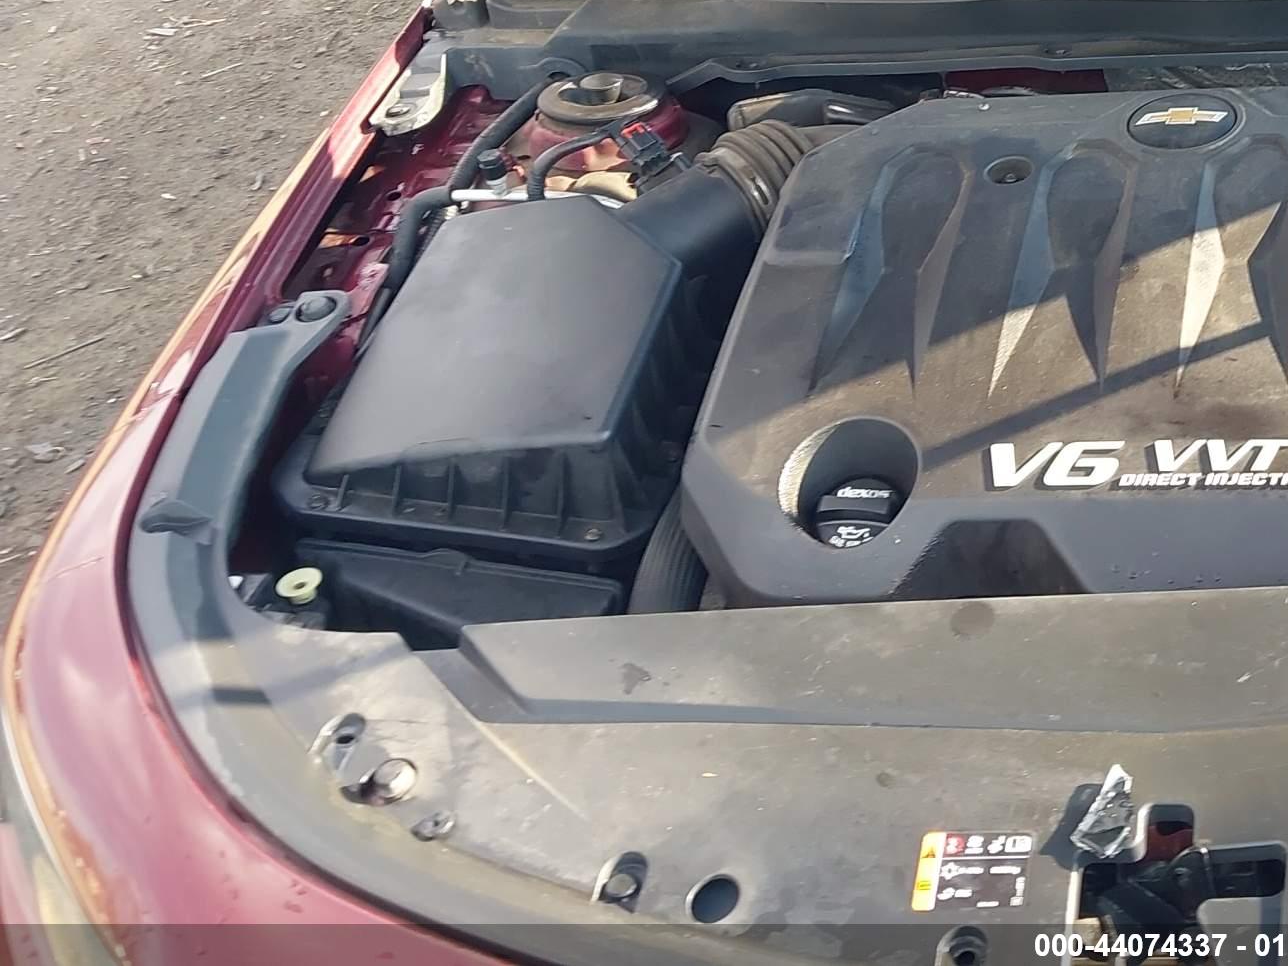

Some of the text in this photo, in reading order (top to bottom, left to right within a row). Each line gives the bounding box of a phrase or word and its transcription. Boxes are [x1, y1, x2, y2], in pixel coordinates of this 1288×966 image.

[990, 440, 1126, 487] V6
[1118, 472, 1202, 487] DIRECT
[836, 486, 893, 499] dexos
